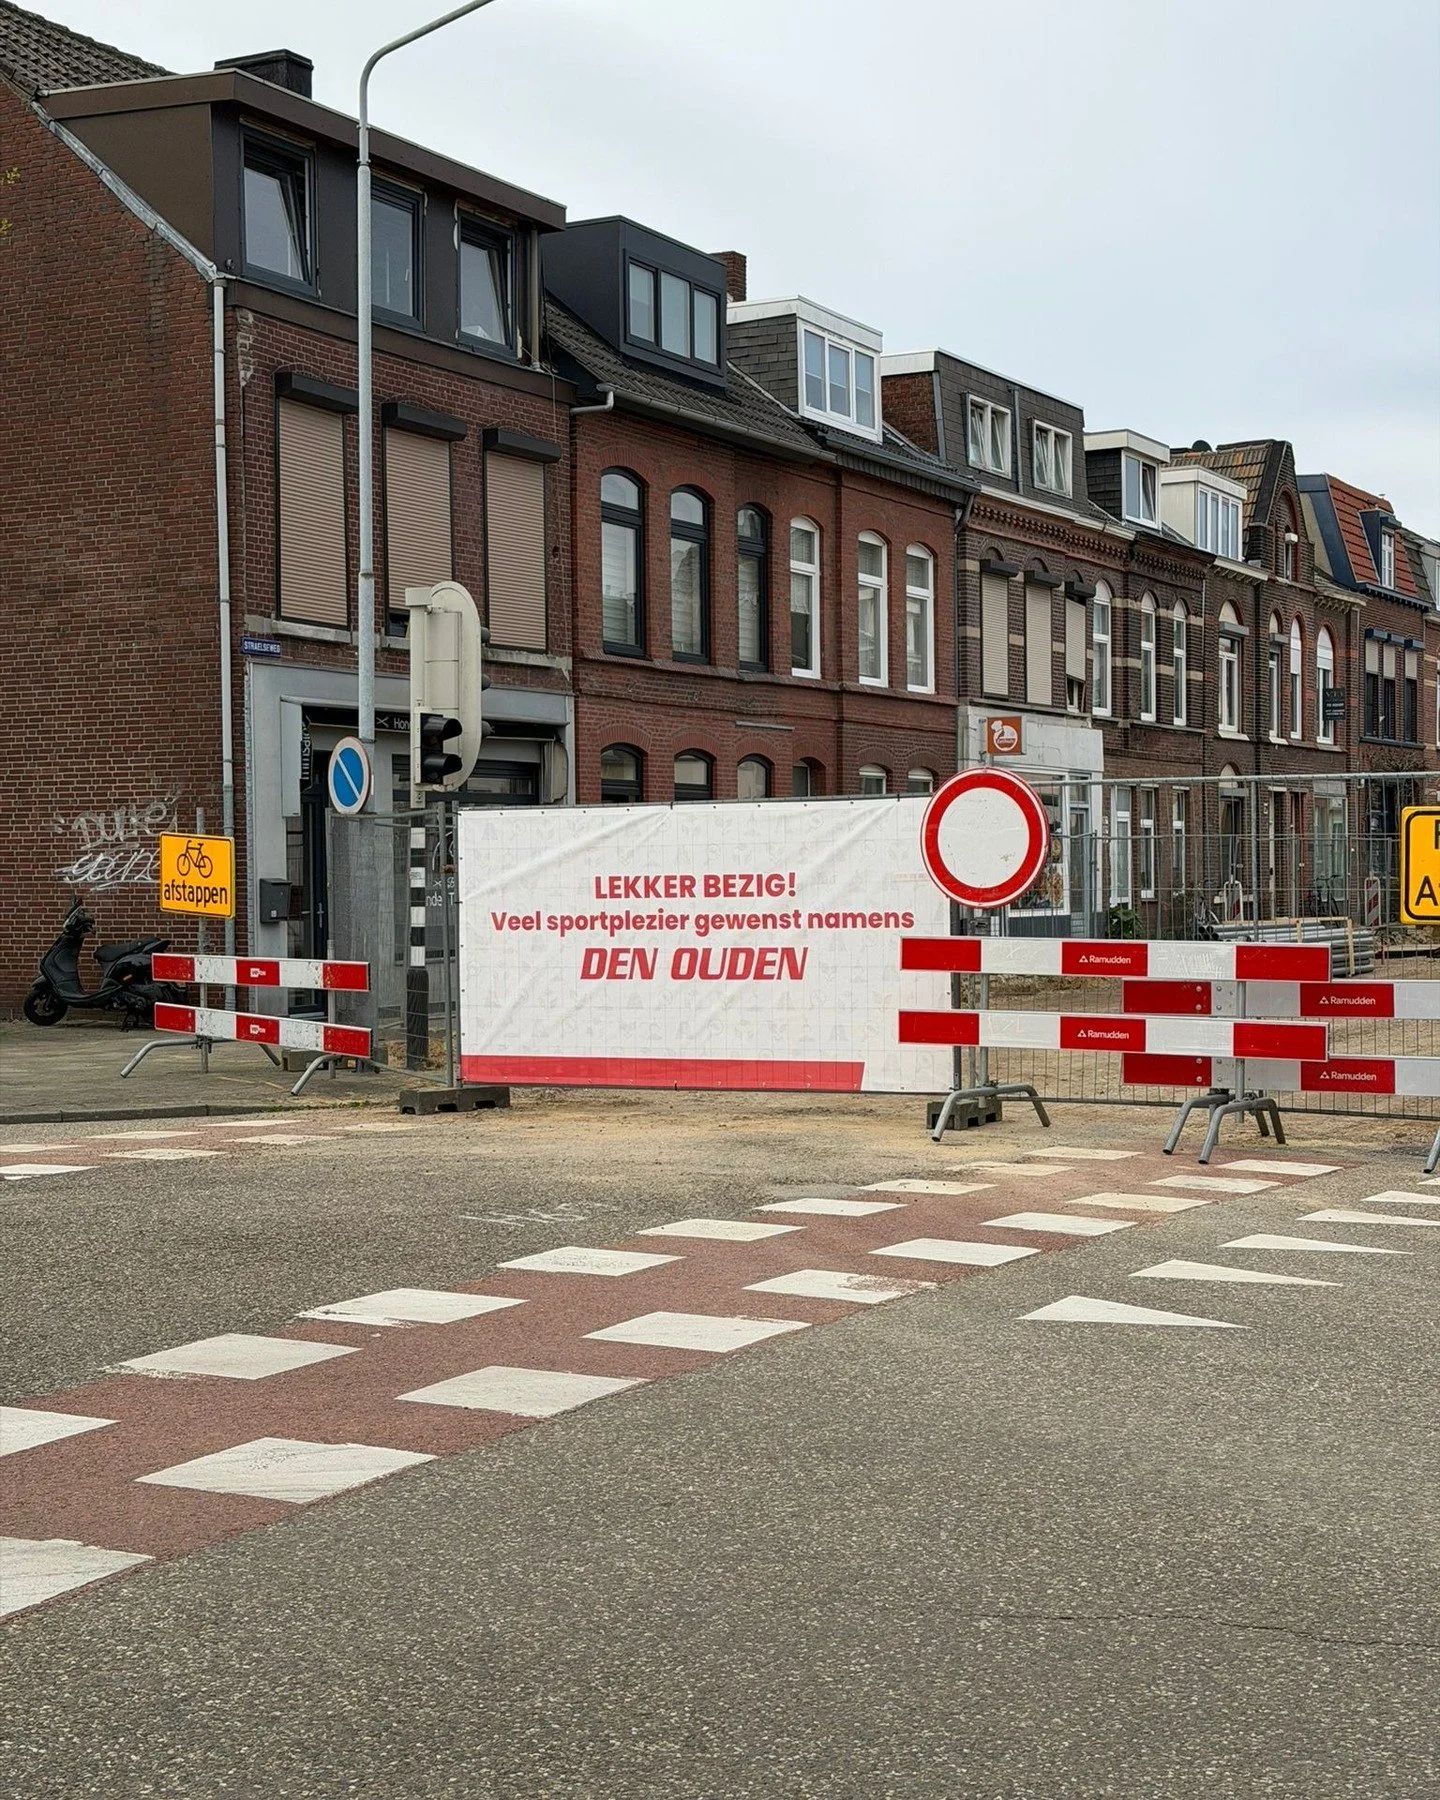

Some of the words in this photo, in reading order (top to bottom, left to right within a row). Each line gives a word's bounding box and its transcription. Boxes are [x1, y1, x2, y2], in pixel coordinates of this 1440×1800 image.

[244, 640, 281, 653] STRAELSEWEG
[393, 717, 410, 730] Hon
[595, 875, 697, 900] LEKKER
[703, 873, 796, 899] BEZIG!
[1415, 875, 1440, 906] A
[163, 879, 228, 908] afstappen
[491, 911, 542, 931] Veel
[547, 910, 689, 938] sportplezier
[694, 910, 802, 938] gewenst
[807, 911, 915, 929] namens
[580, 947, 658, 981] DEN
[670, 947, 809, 982] OUDEN
[1089, 955, 1131, 964] Ramudden
[1330, 996, 1376, 1005] Ramudden
[1087, 1029, 1130, 1039] Ramudden
[1330, 1071, 1377, 1081] Ramudden
